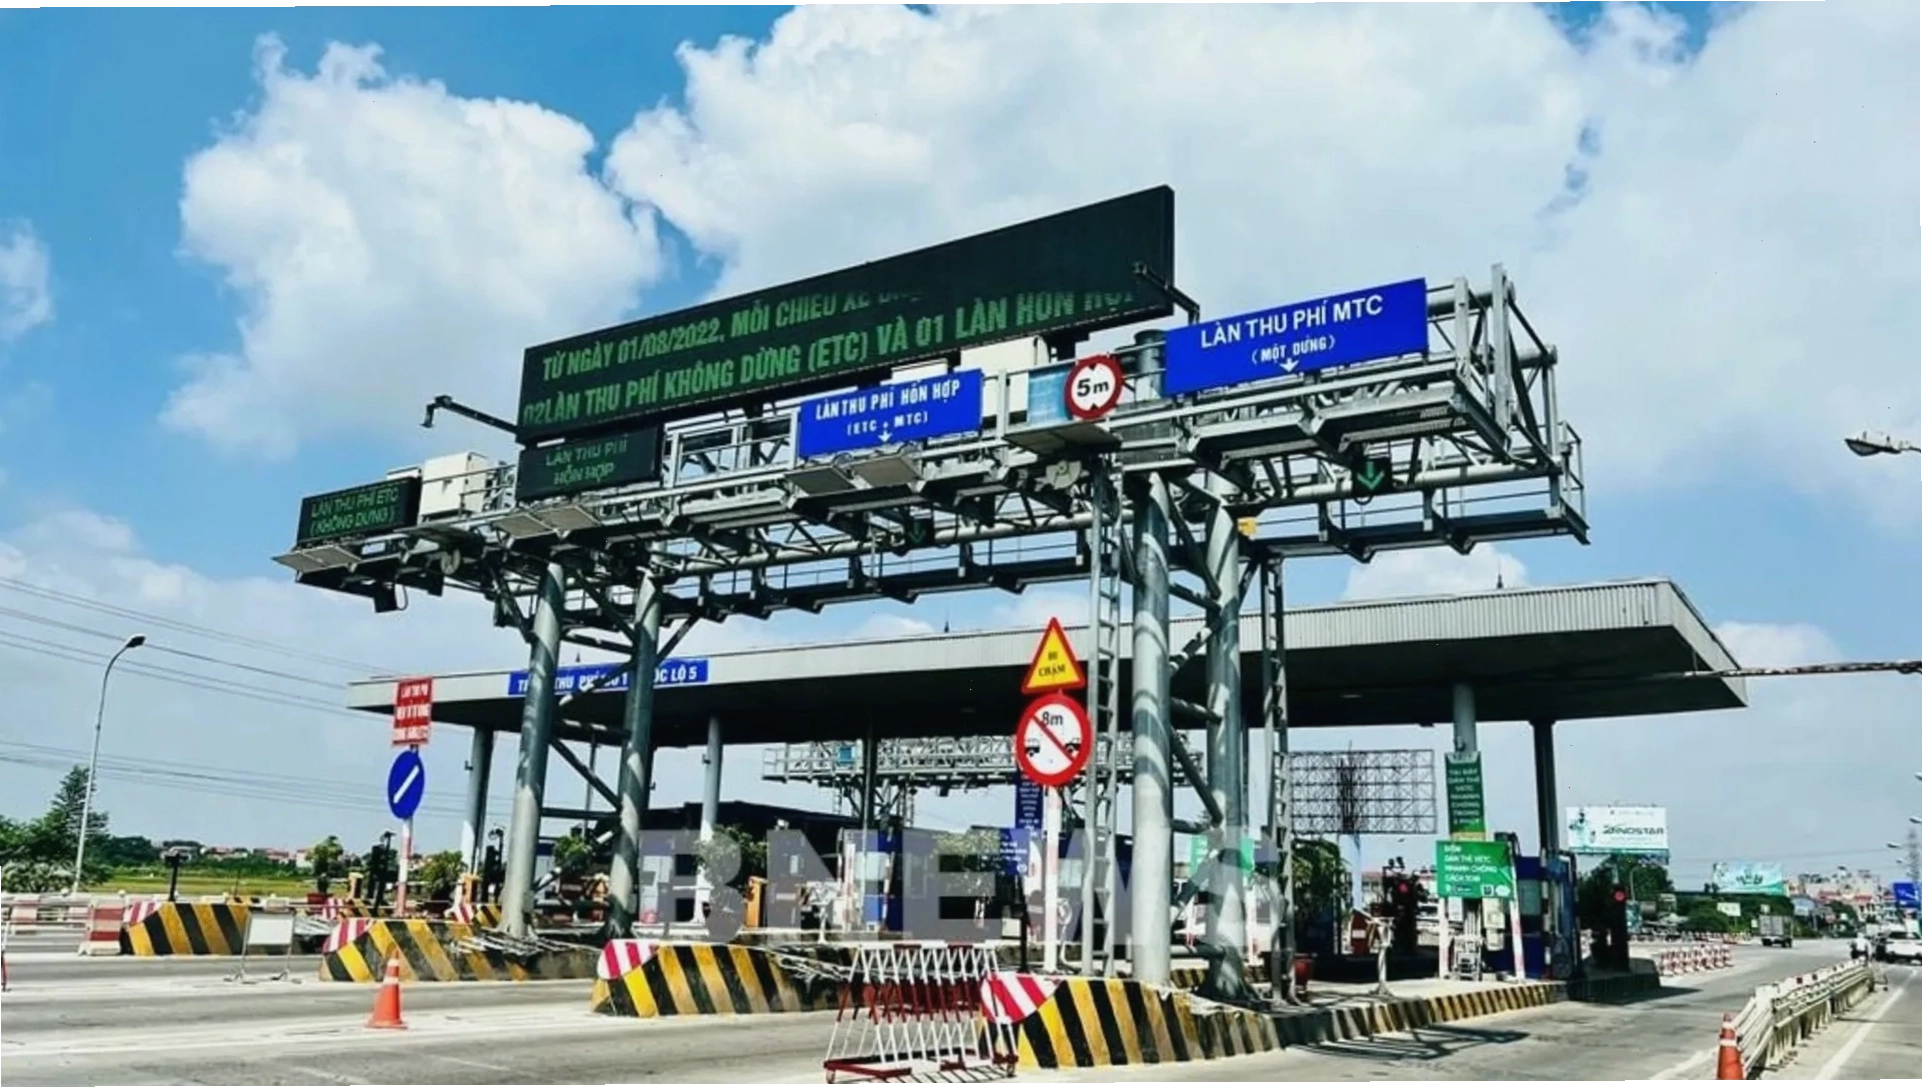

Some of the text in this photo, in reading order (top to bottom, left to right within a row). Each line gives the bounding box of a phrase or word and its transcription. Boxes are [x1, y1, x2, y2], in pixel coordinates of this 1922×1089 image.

[1201, 295, 1382, 348] LÀN THU PHÍ MTC
[567, 341, 613, 376] NGÀY
[584, 383, 621, 415] THU
[625, 370, 660, 408] PHÍ
[664, 360, 734, 400] KHÔNG
[740, 344, 801, 384] DỪNG
[808, 331, 868, 373] (ETC)
[876, 314, 908, 355] VÀ
[915, 314, 944, 347] 01
[955, 297, 1007, 339] LÀN
[816, 399, 839, 420] LÀN
[842, 396, 866, 416] THU
[871, 387, 894, 410] PHÍ
[932, 379, 960, 403] HỢP
[847, 419, 877, 436] (ETC
[894, 411, 928, 428] MTC)
[576, 445, 600, 460] THU
[689, 666, 697, 681] 5
[1042, 711, 1063, 726] 8m
